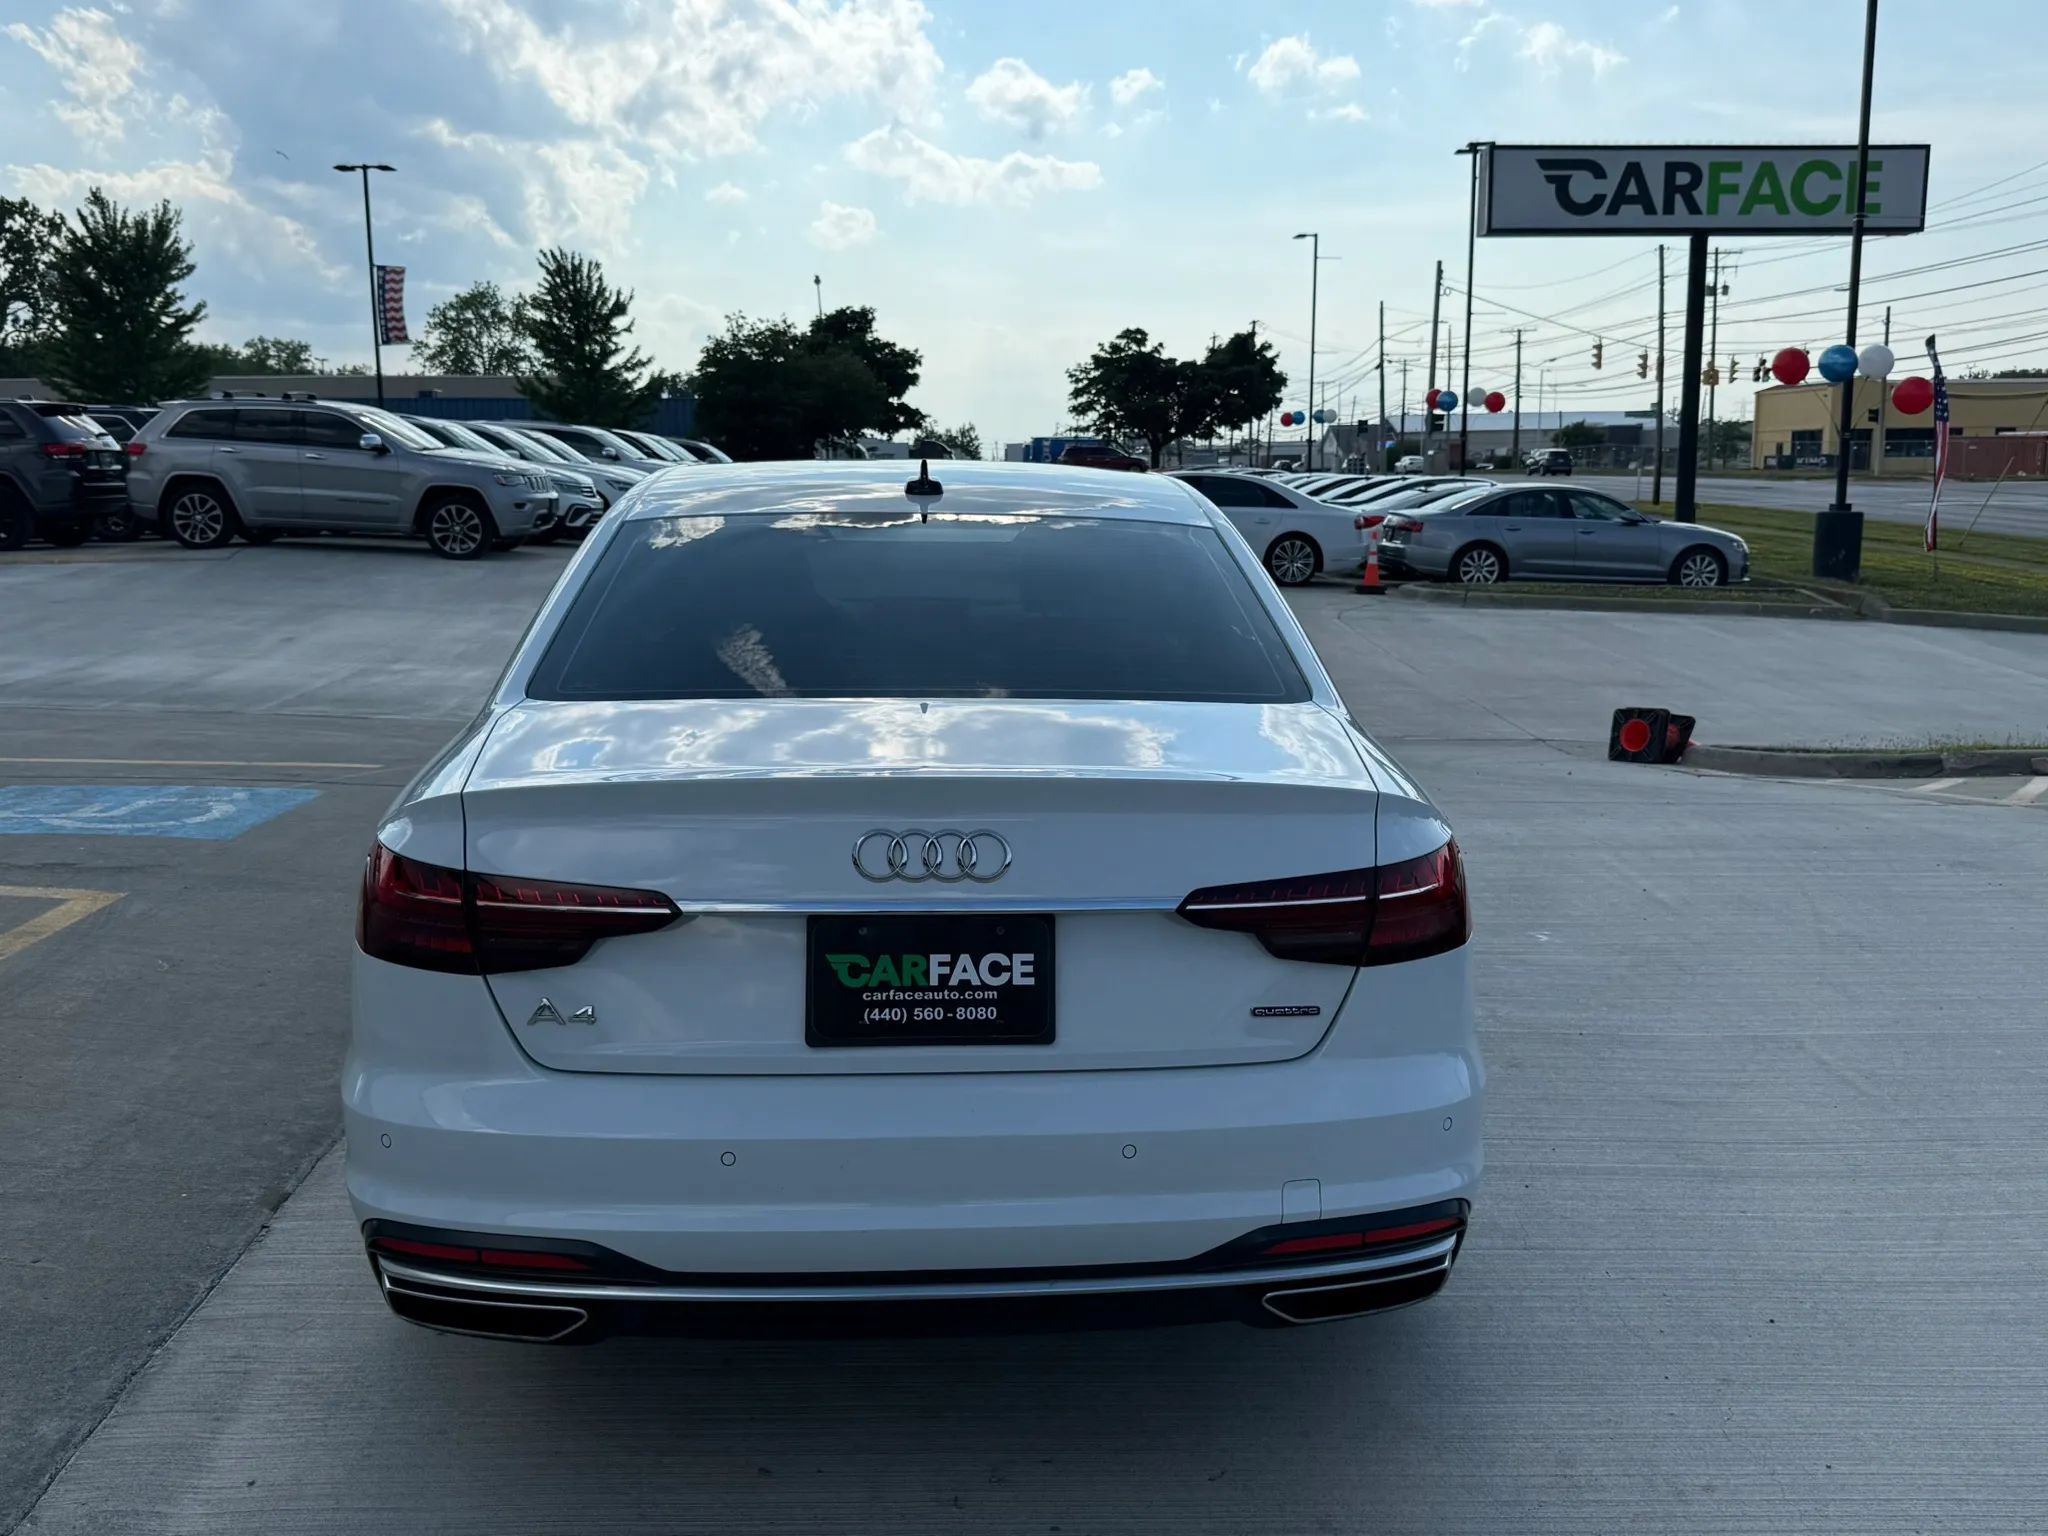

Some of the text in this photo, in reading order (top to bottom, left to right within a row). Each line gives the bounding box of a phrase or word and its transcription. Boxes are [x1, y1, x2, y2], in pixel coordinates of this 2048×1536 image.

[1535, 158, 1884, 217] CARFACE
[825, 953, 1036, 988] CARFACE
[862, 989, 998, 1001] carfaceauto.com
[526, 997, 597, 1026] A4
[863, 1007, 907, 1024] (440)
[1254, 1006, 1319, 1016] quattro
